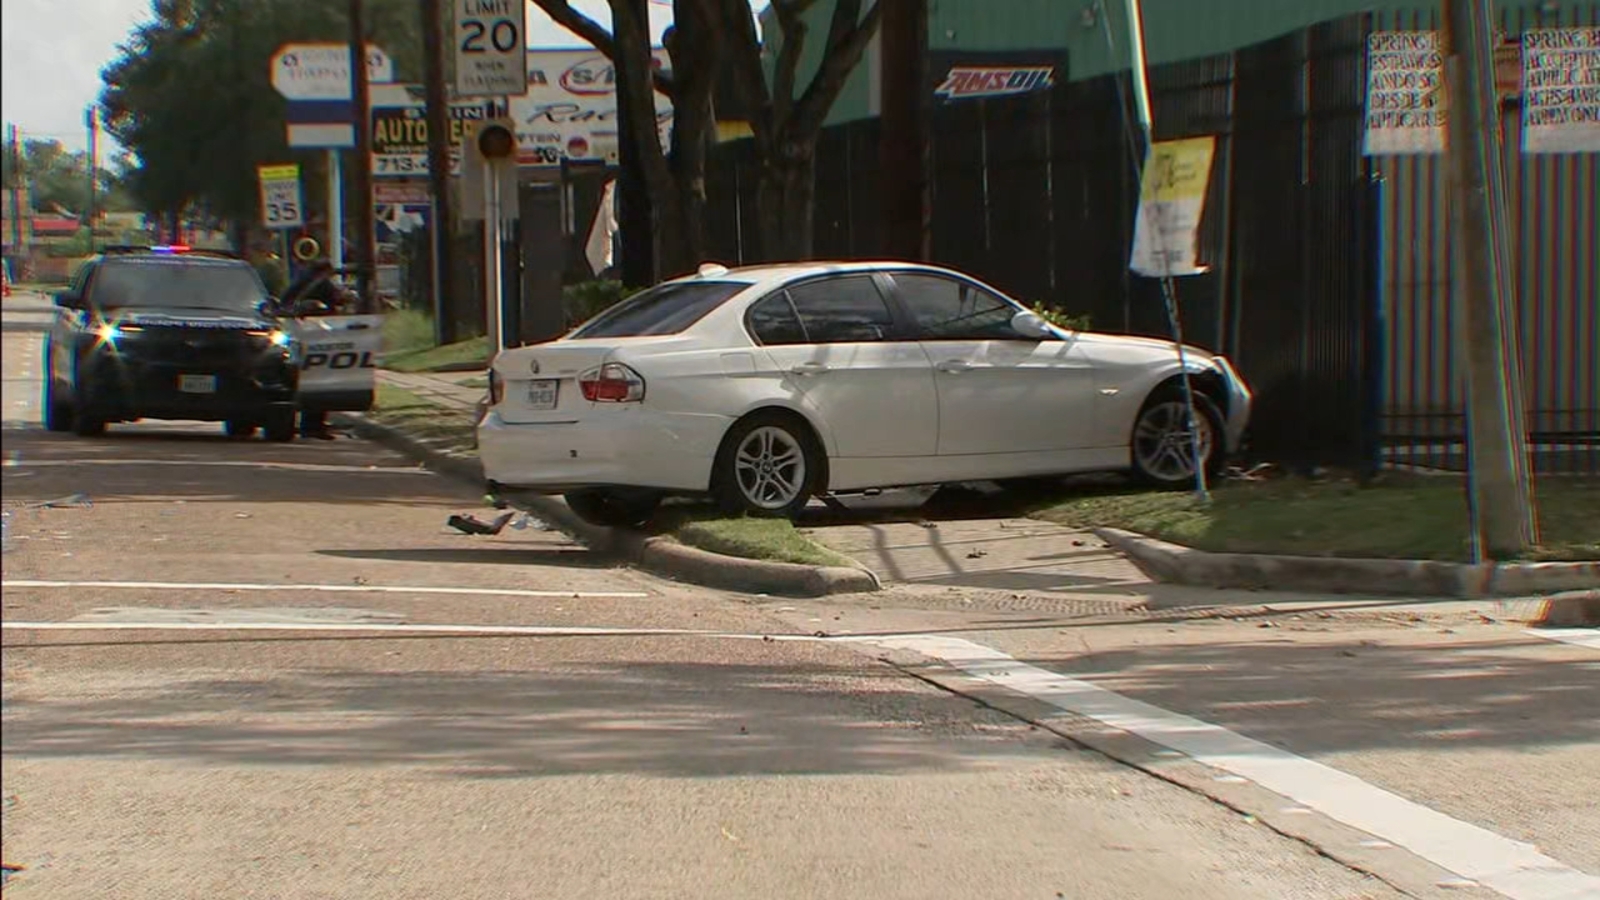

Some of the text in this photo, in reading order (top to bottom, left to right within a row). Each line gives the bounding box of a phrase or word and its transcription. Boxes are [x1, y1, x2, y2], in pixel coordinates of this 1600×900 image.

[464, 0, 511, 15] LIMIT
[461, 20, 517, 52] 20
[935, 66, 1054, 98] AMSOIL
[374, 118, 428, 142] AUTO
[267, 202, 298, 222] 35
